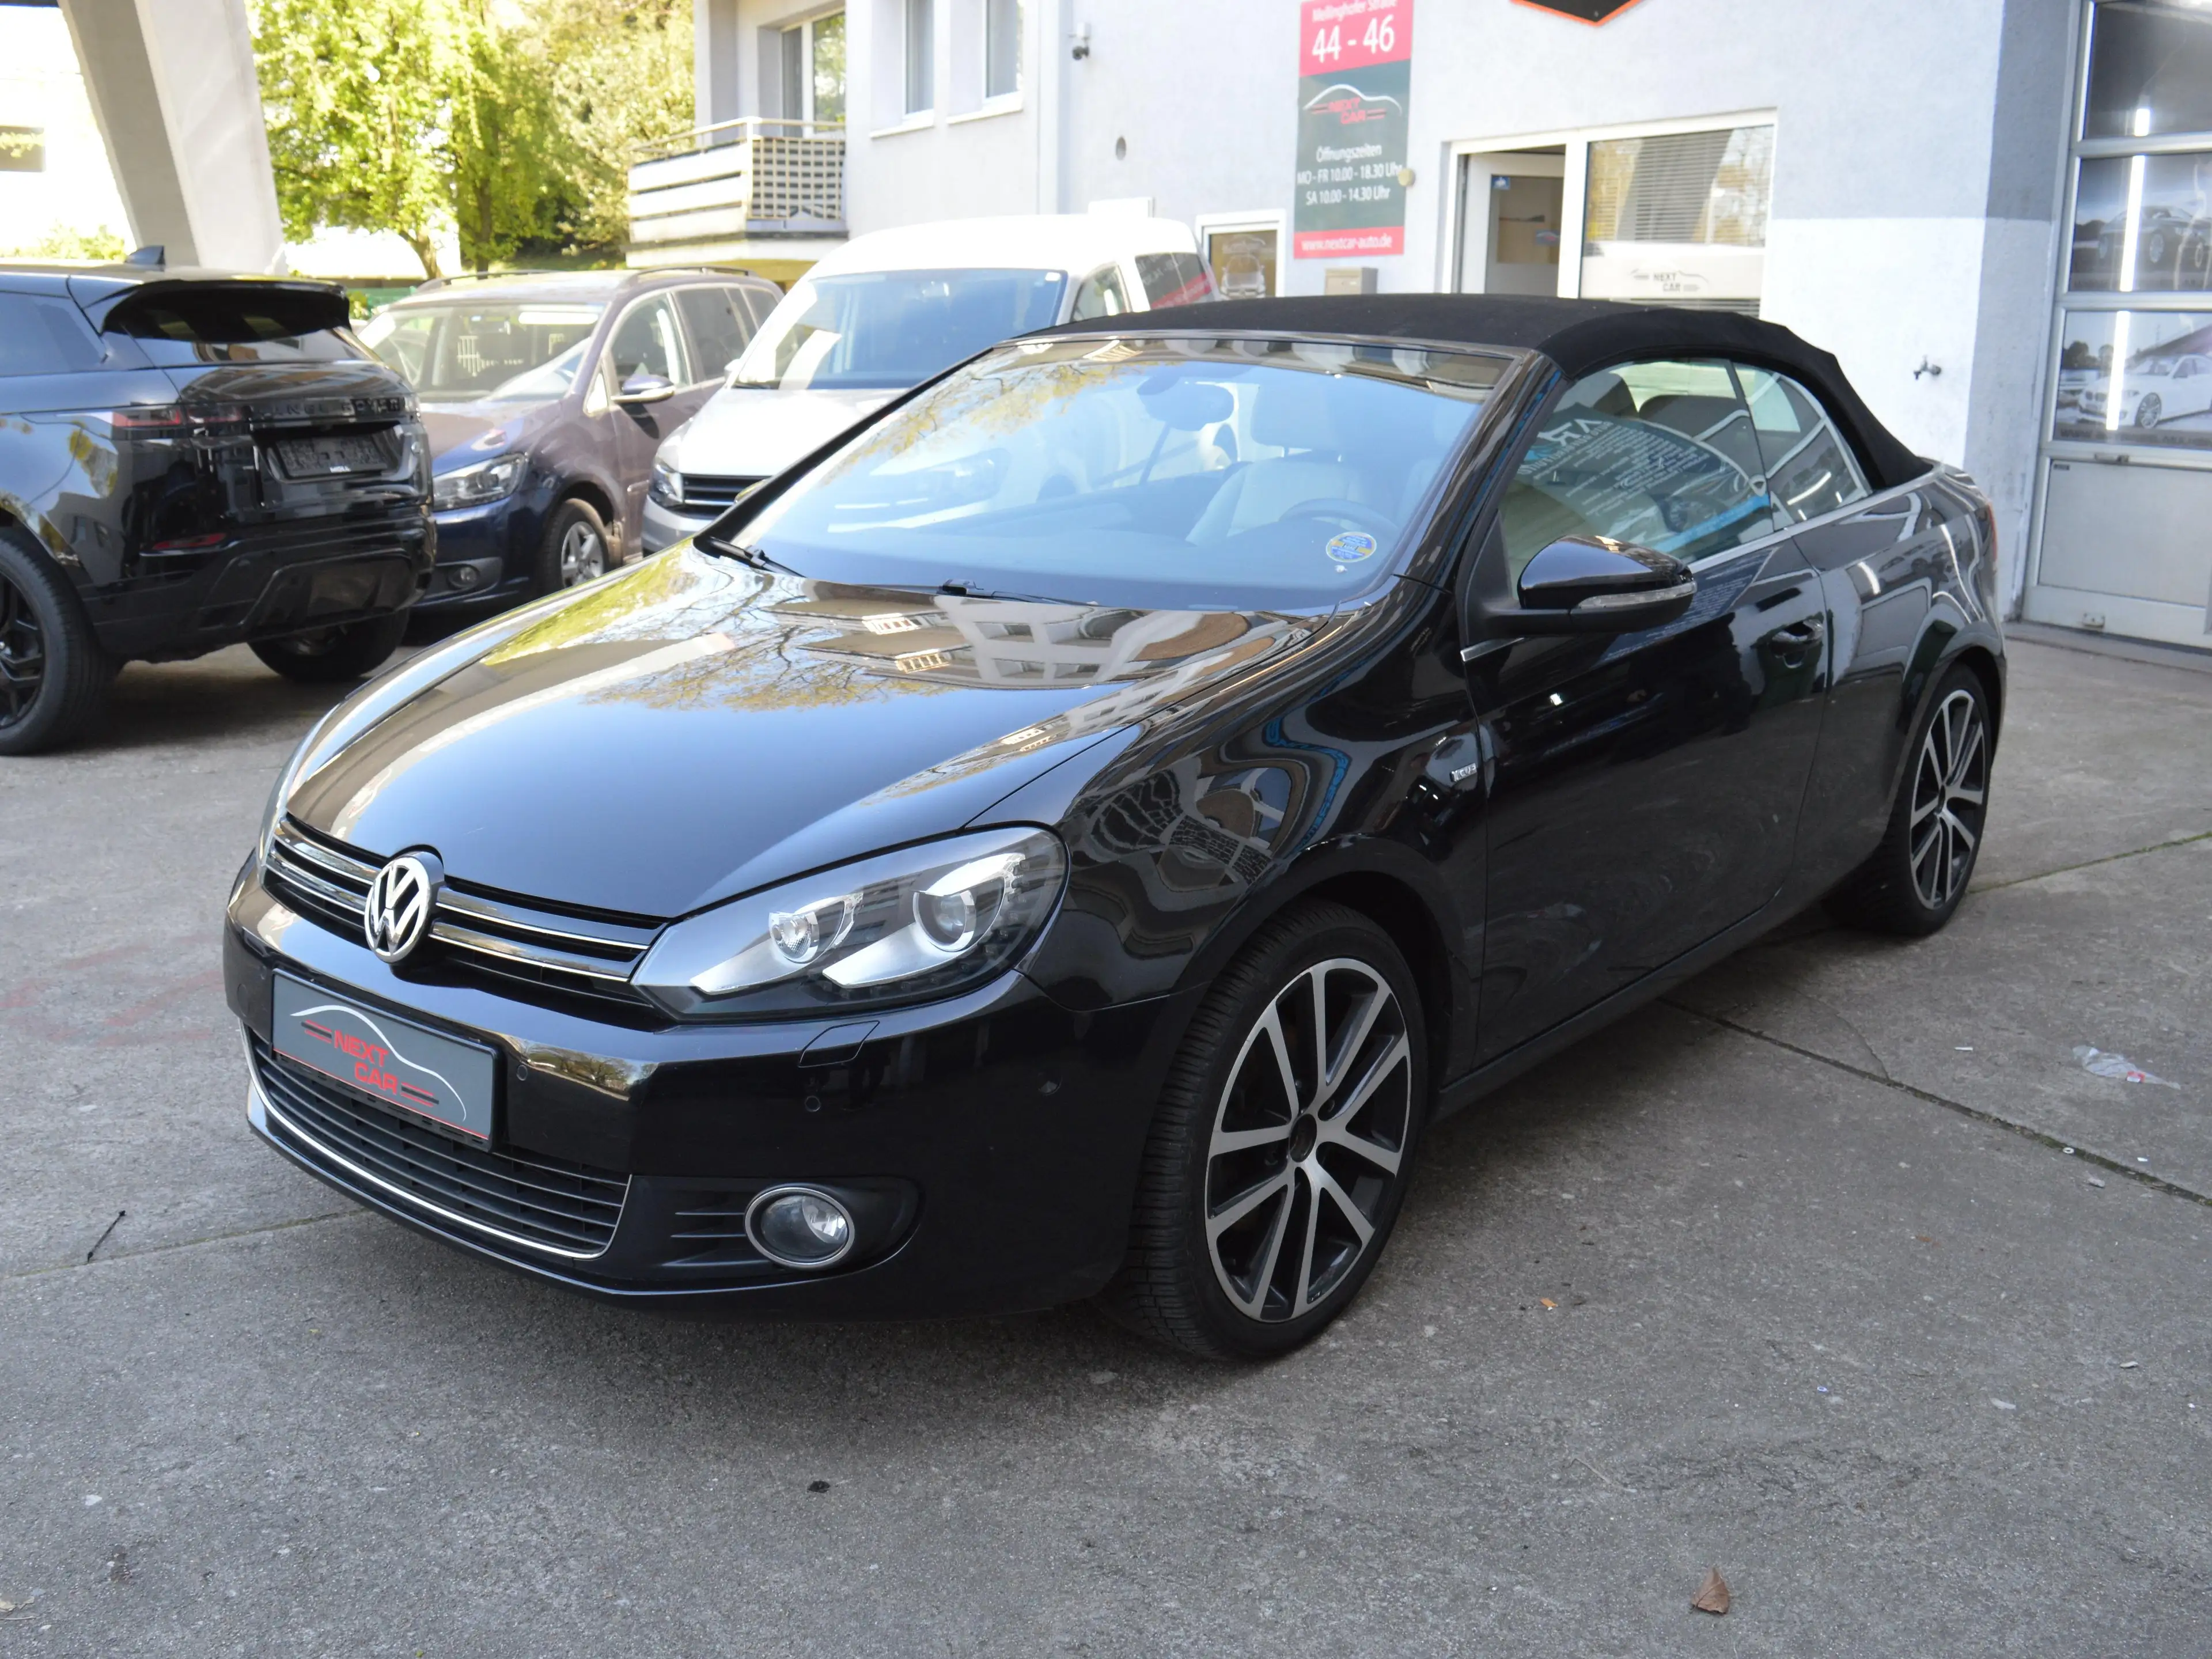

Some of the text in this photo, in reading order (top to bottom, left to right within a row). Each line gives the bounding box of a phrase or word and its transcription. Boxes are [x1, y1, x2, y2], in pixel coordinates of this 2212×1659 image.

[1312, 25, 1342, 63] 44
[1362, 14, 1395, 54] 46
[1306, 191, 1318, 206] SA
[1373, 184, 1391, 200] Uhr
[1654, 272, 1677, 282] NEXT
[1663, 283, 1681, 292] CAR
[334, 1030, 388, 1067] NEXT
[354, 1062, 397, 1094] CAR
